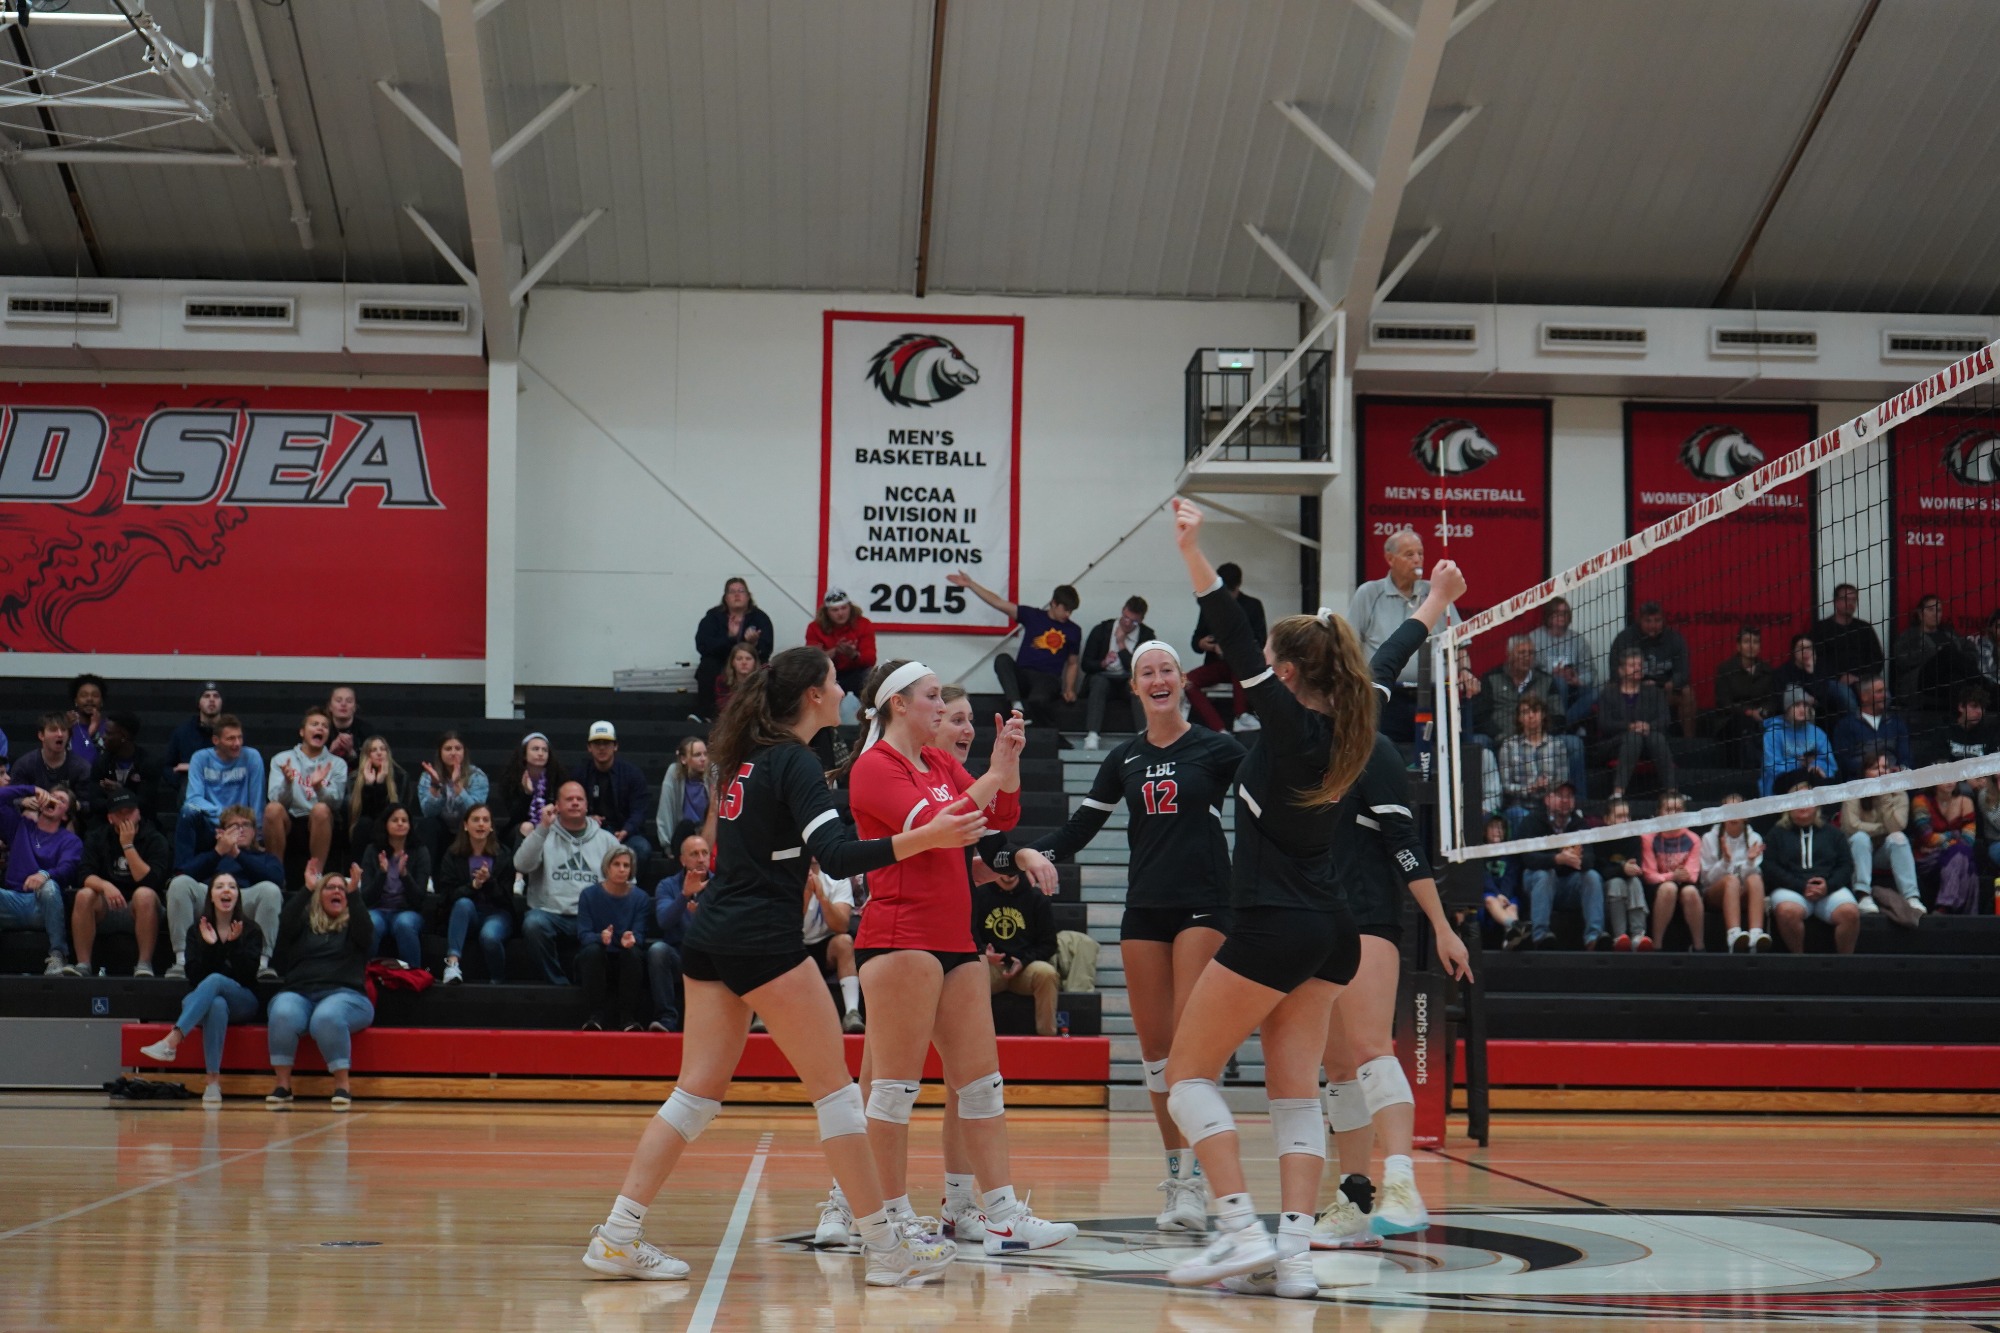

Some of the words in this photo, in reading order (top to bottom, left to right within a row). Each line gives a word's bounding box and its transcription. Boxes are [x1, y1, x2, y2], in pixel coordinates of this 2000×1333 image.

[888, 429, 954, 446] MEN'S
[0, 405, 109, 503] D
[124, 407, 446, 509] SEA
[855, 448, 987, 467] BASKETBALL
[885, 486, 955, 503] NCCAA
[1384, 486, 1430, 499] MEN'S
[1434, 487, 1526, 502] BASKETBALL
[1640, 491, 1709, 506] WOMEN'S
[1919, 496, 1988, 511] WOMEN'S
[863, 506, 956, 523] DIVISION
[964, 508, 976, 523] II
[868, 526, 971, 544] NATIONAL
[1434, 523, 1475, 538] 2018
[1906, 530, 1945, 547] 2012
[855, 547, 983, 564] CHAMPIONS
[870, 584, 966, 614] 2015
[1145, 761, 1176, 777] LBC
[1141, 779, 1178, 814] 12
[1395, 849, 1419, 872] GERS
[551, 870, 599, 883] adidas
[1414, 992, 1428, 1033] sports
[1414, 1034, 1428, 1085] imports
